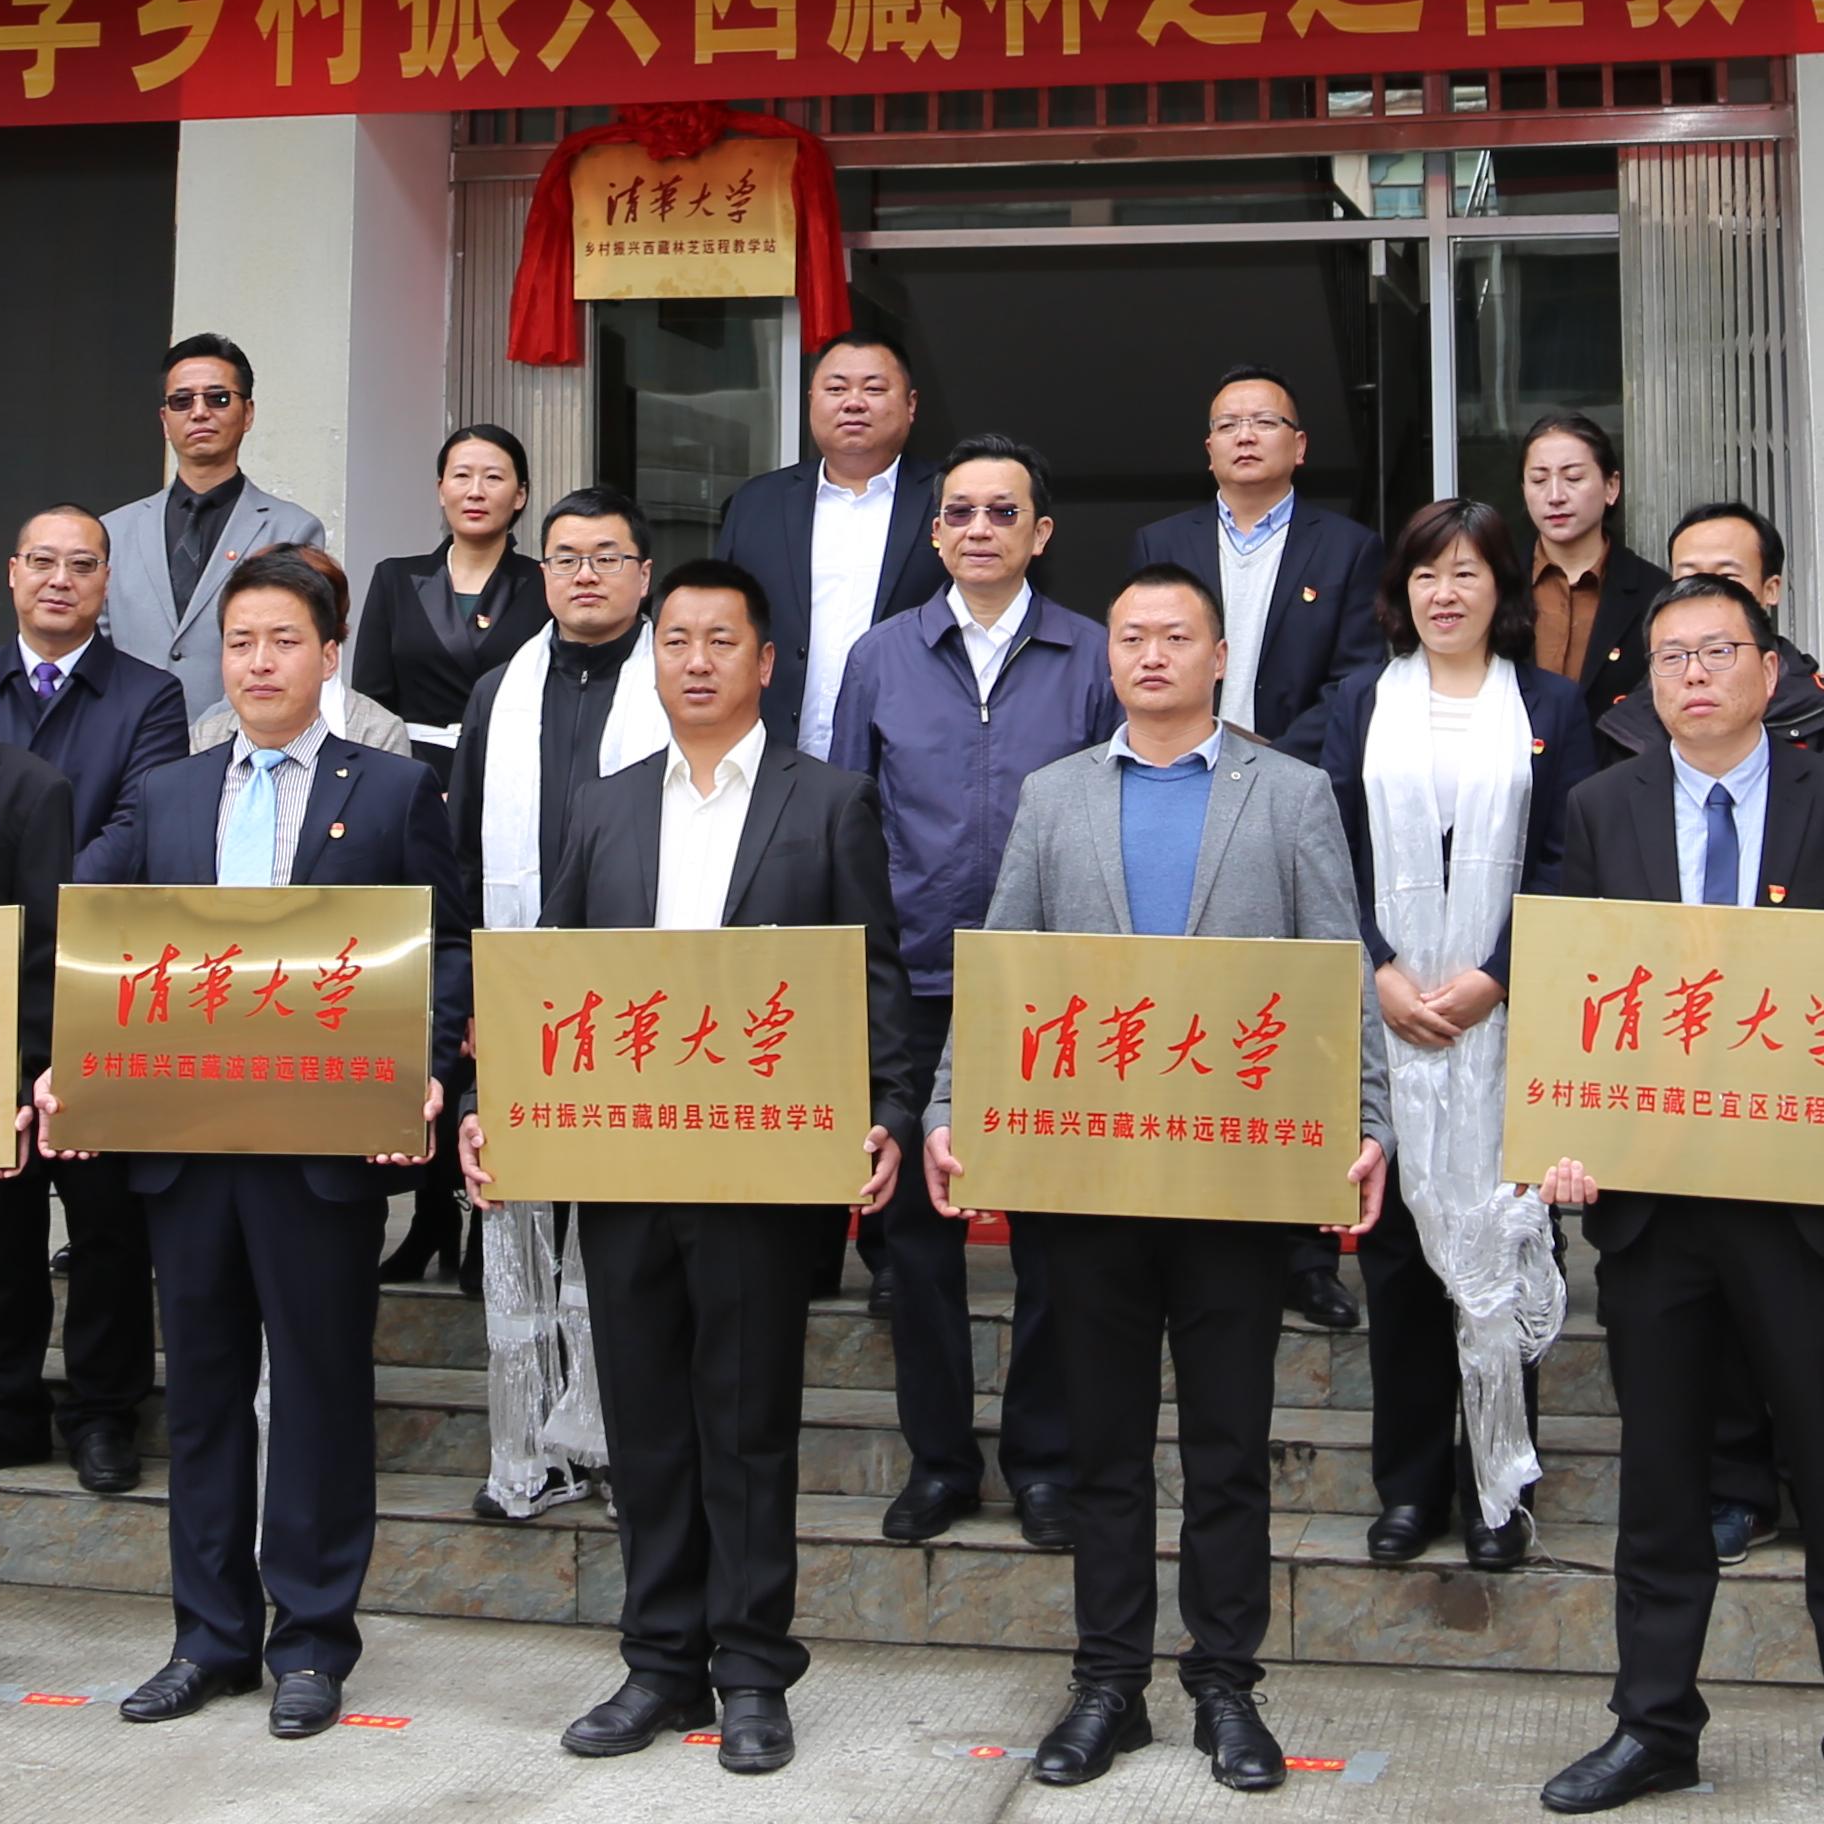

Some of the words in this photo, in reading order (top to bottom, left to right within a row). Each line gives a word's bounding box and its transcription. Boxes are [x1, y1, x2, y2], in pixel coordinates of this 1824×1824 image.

[585, 238, 777, 257] 乡村振兴西藏林芝远程教学站
[81, 1052, 397, 1084] 乡村振兴西藏波密远程教学站
[509, 1102, 835, 1132] 乡村振兴西藏朗县远程教学站
[983, 1106, 1325, 1148] 乡村振兴西藏米林远程教学站
